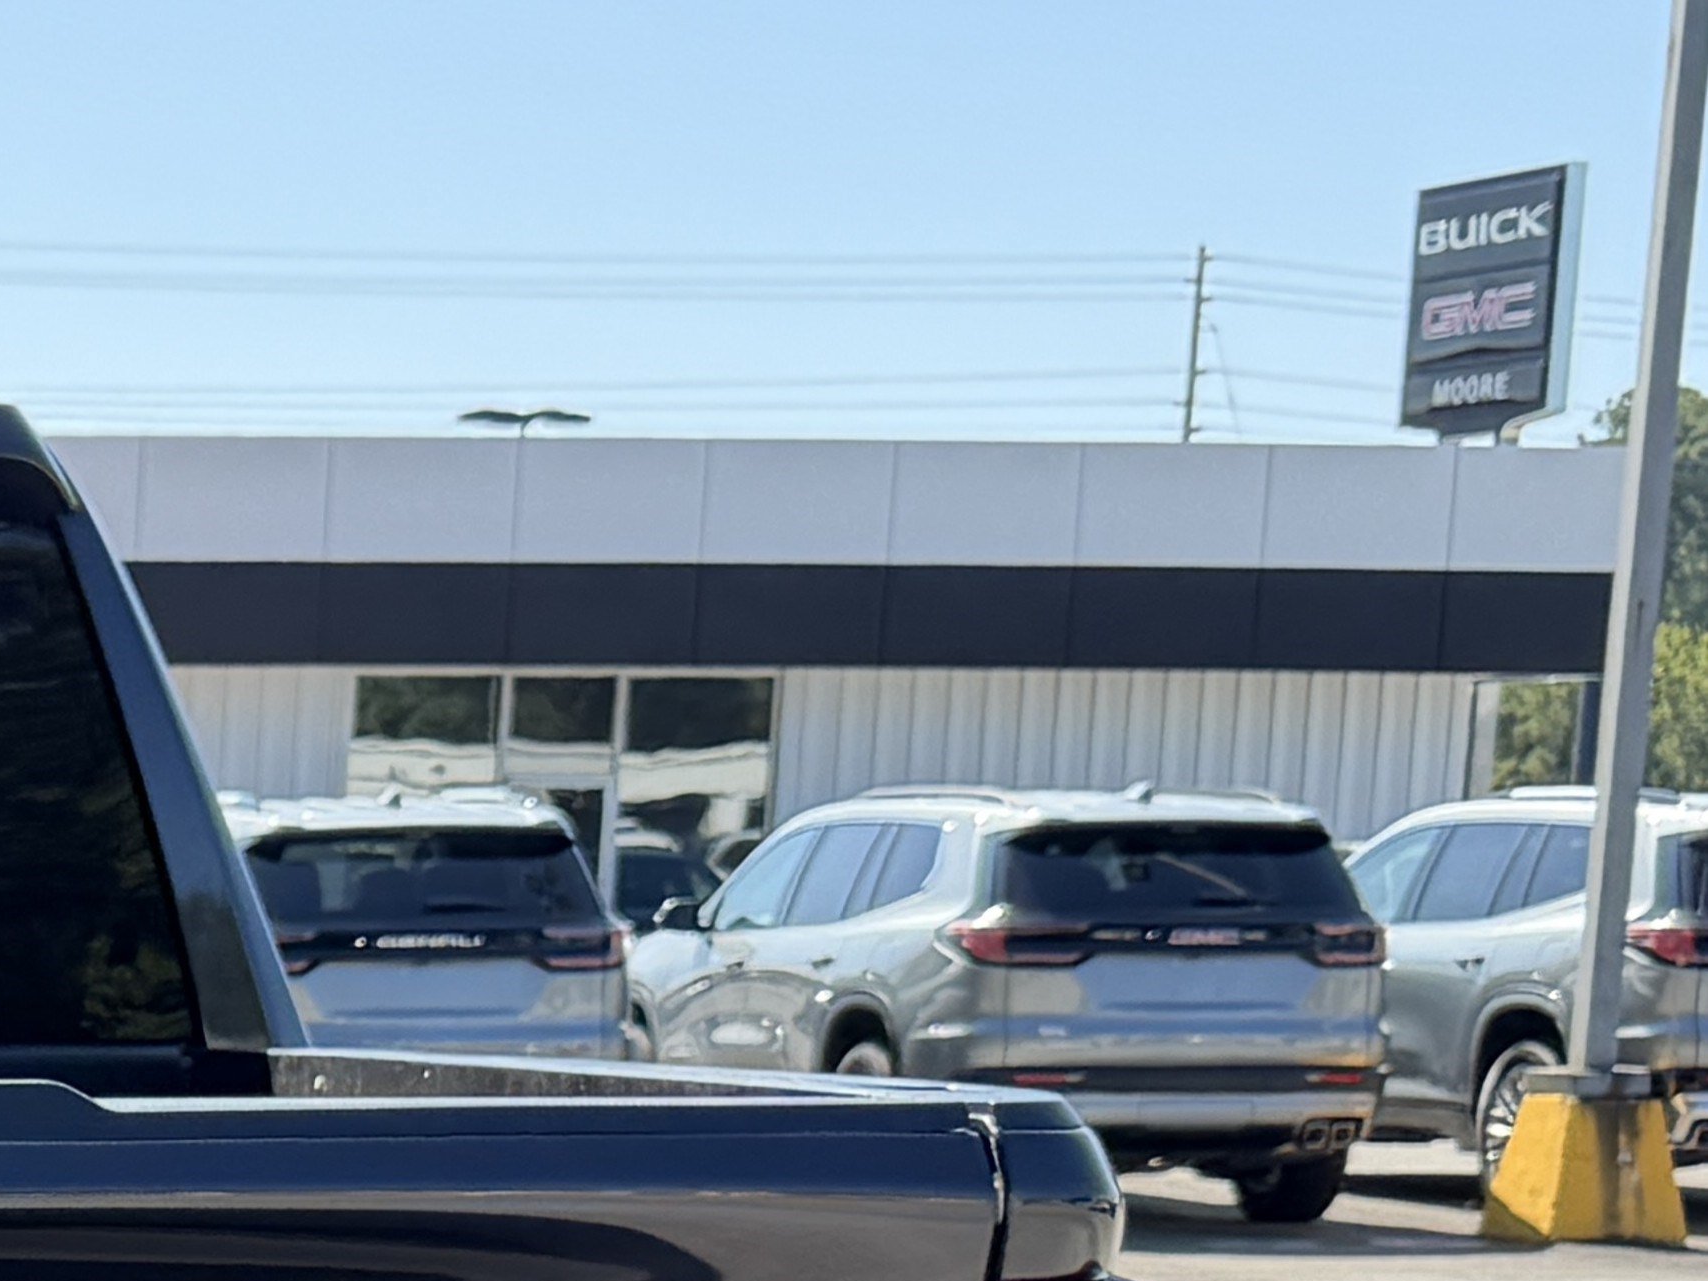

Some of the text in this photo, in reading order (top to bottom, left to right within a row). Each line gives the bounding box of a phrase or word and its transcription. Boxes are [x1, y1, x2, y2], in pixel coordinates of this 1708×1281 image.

[1419, 201, 1552, 256] BUICK
[1423, 282, 1537, 340] GMC
[1432, 372, 1511, 405] MOORE
